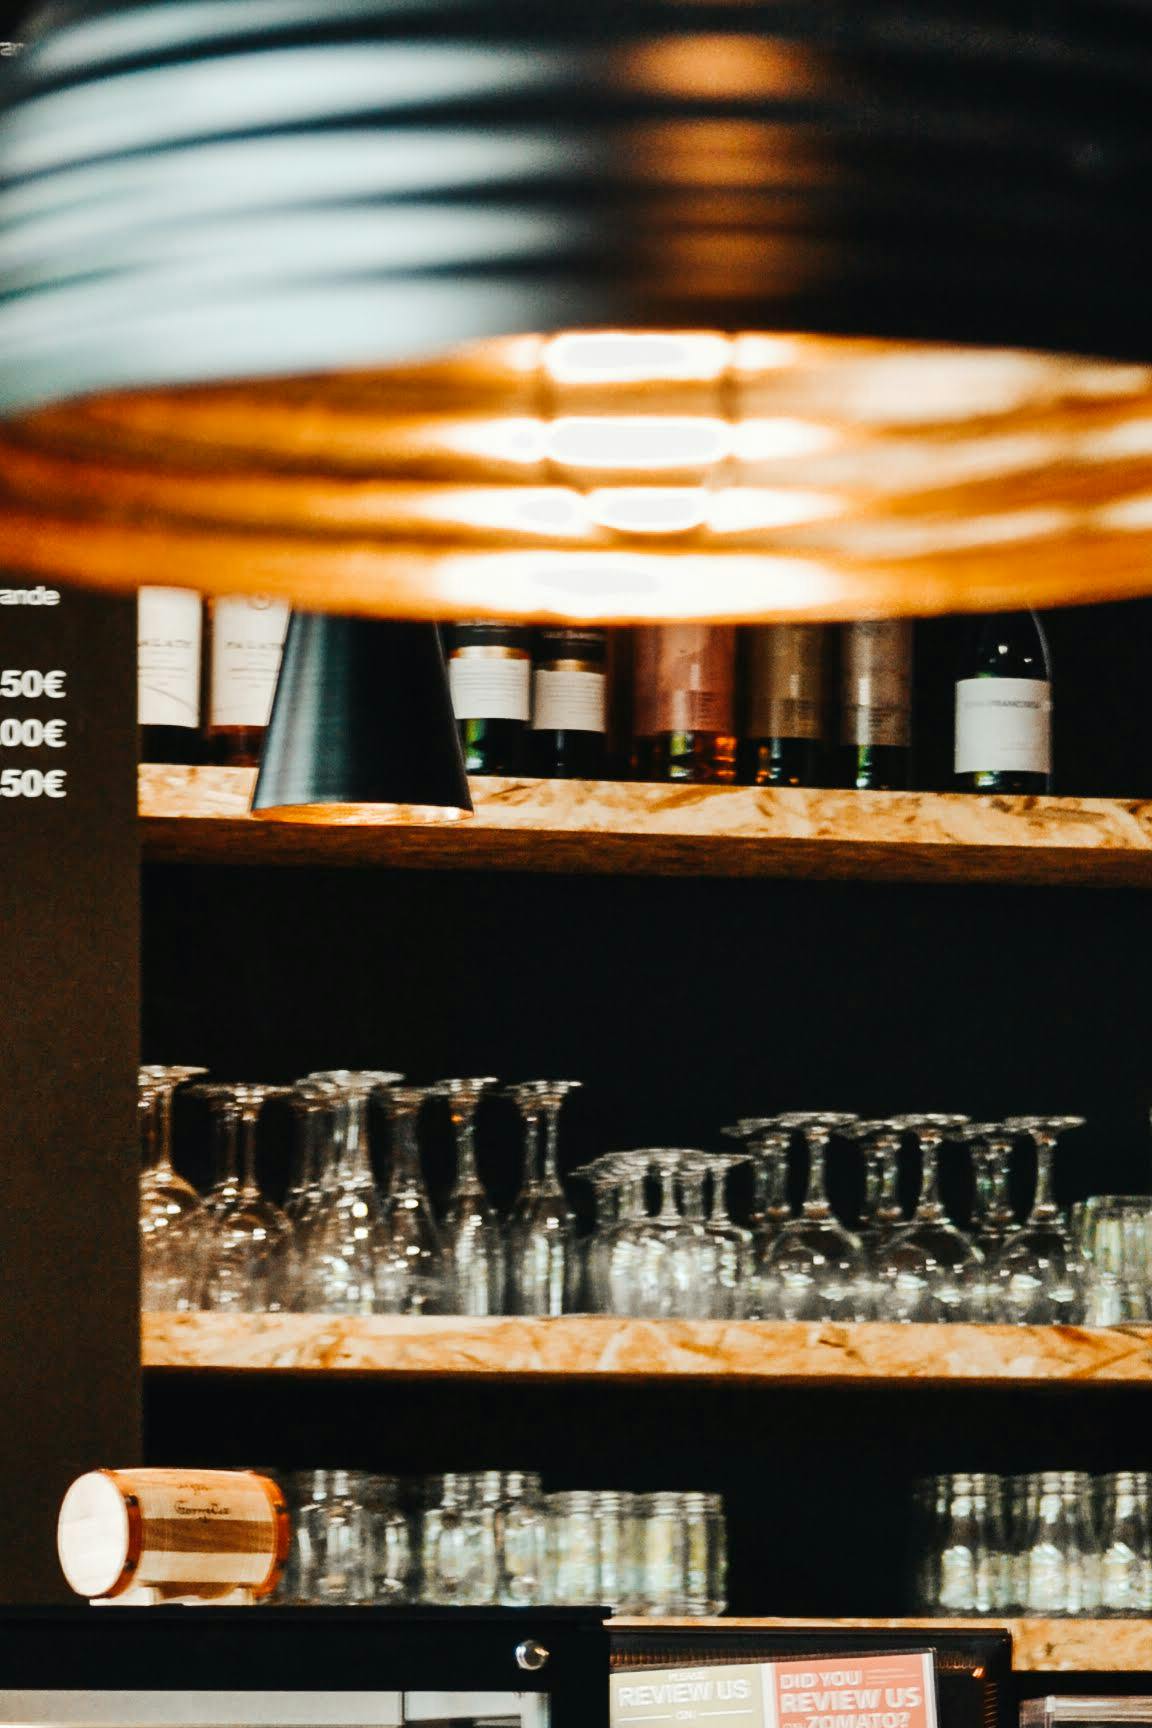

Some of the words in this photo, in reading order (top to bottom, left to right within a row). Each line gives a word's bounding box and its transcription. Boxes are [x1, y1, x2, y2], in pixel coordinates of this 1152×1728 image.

[0, 670, 67, 698] 50€
[0, 719, 67, 748] 00€
[0, 769, 67, 798] 50€
[618, 1681, 710, 1707] REVIEW
[716, 1679, 750, 1700] US
[780, 1672, 817, 1690] DID
[818, 1670, 862, 1688] YOU
[780, 1689, 882, 1713] REVIEW
[885, 1687, 921, 1709] US
